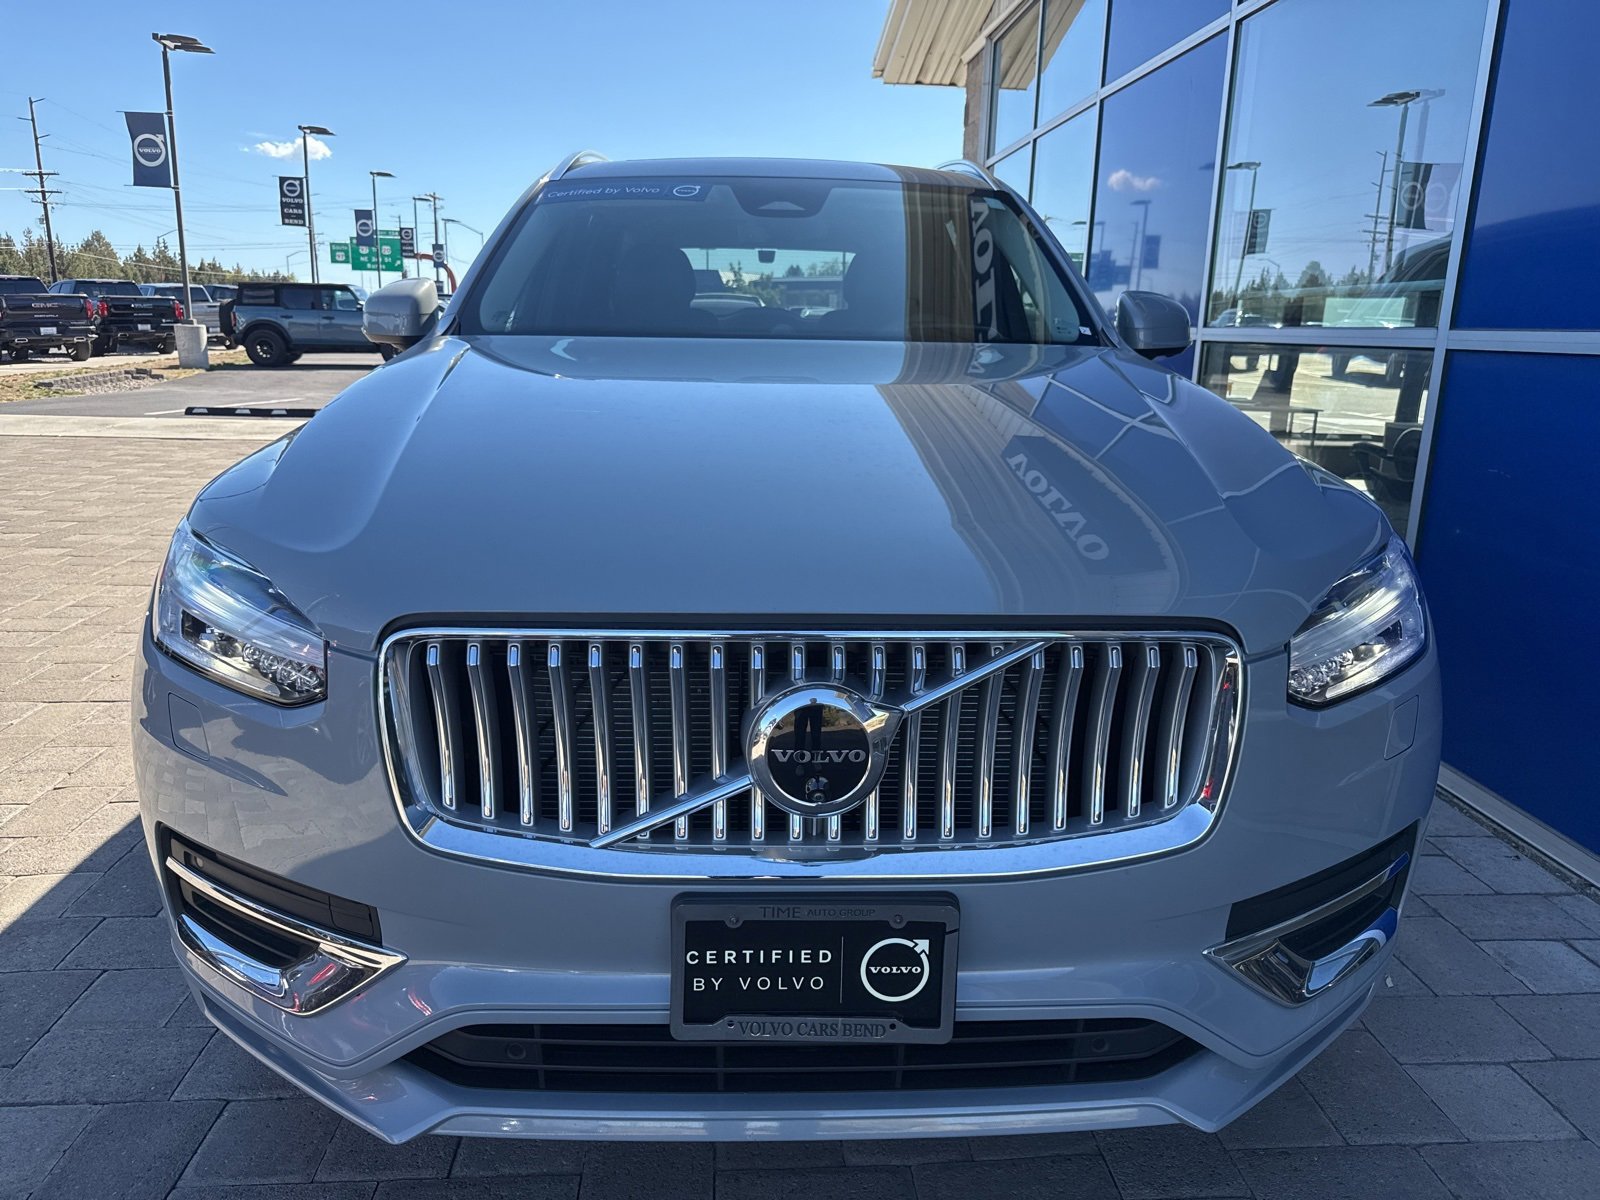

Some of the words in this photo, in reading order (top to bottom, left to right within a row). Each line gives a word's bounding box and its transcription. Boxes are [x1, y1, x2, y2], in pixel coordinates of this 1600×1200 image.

[547, 187, 601, 198] Certified
[604, 187, 622, 195] by
[625, 186, 660, 194] Volvo
[771, 749, 867, 763] VOLVO
[758, 906, 800, 918] TIME
[806, 909, 836, 917] AUTO
[839, 908, 876, 917] GROUP
[686, 950, 832, 965] CERTIFIED
[868, 966, 922, 974] VOLVO
[693, 977, 724, 991] BY
[739, 976, 825, 991] VOLVO
[738, 1021, 794, 1037] VOLVO
[796, 1021, 839, 1037] CARS
[841, 1022, 887, 1038] BEND
